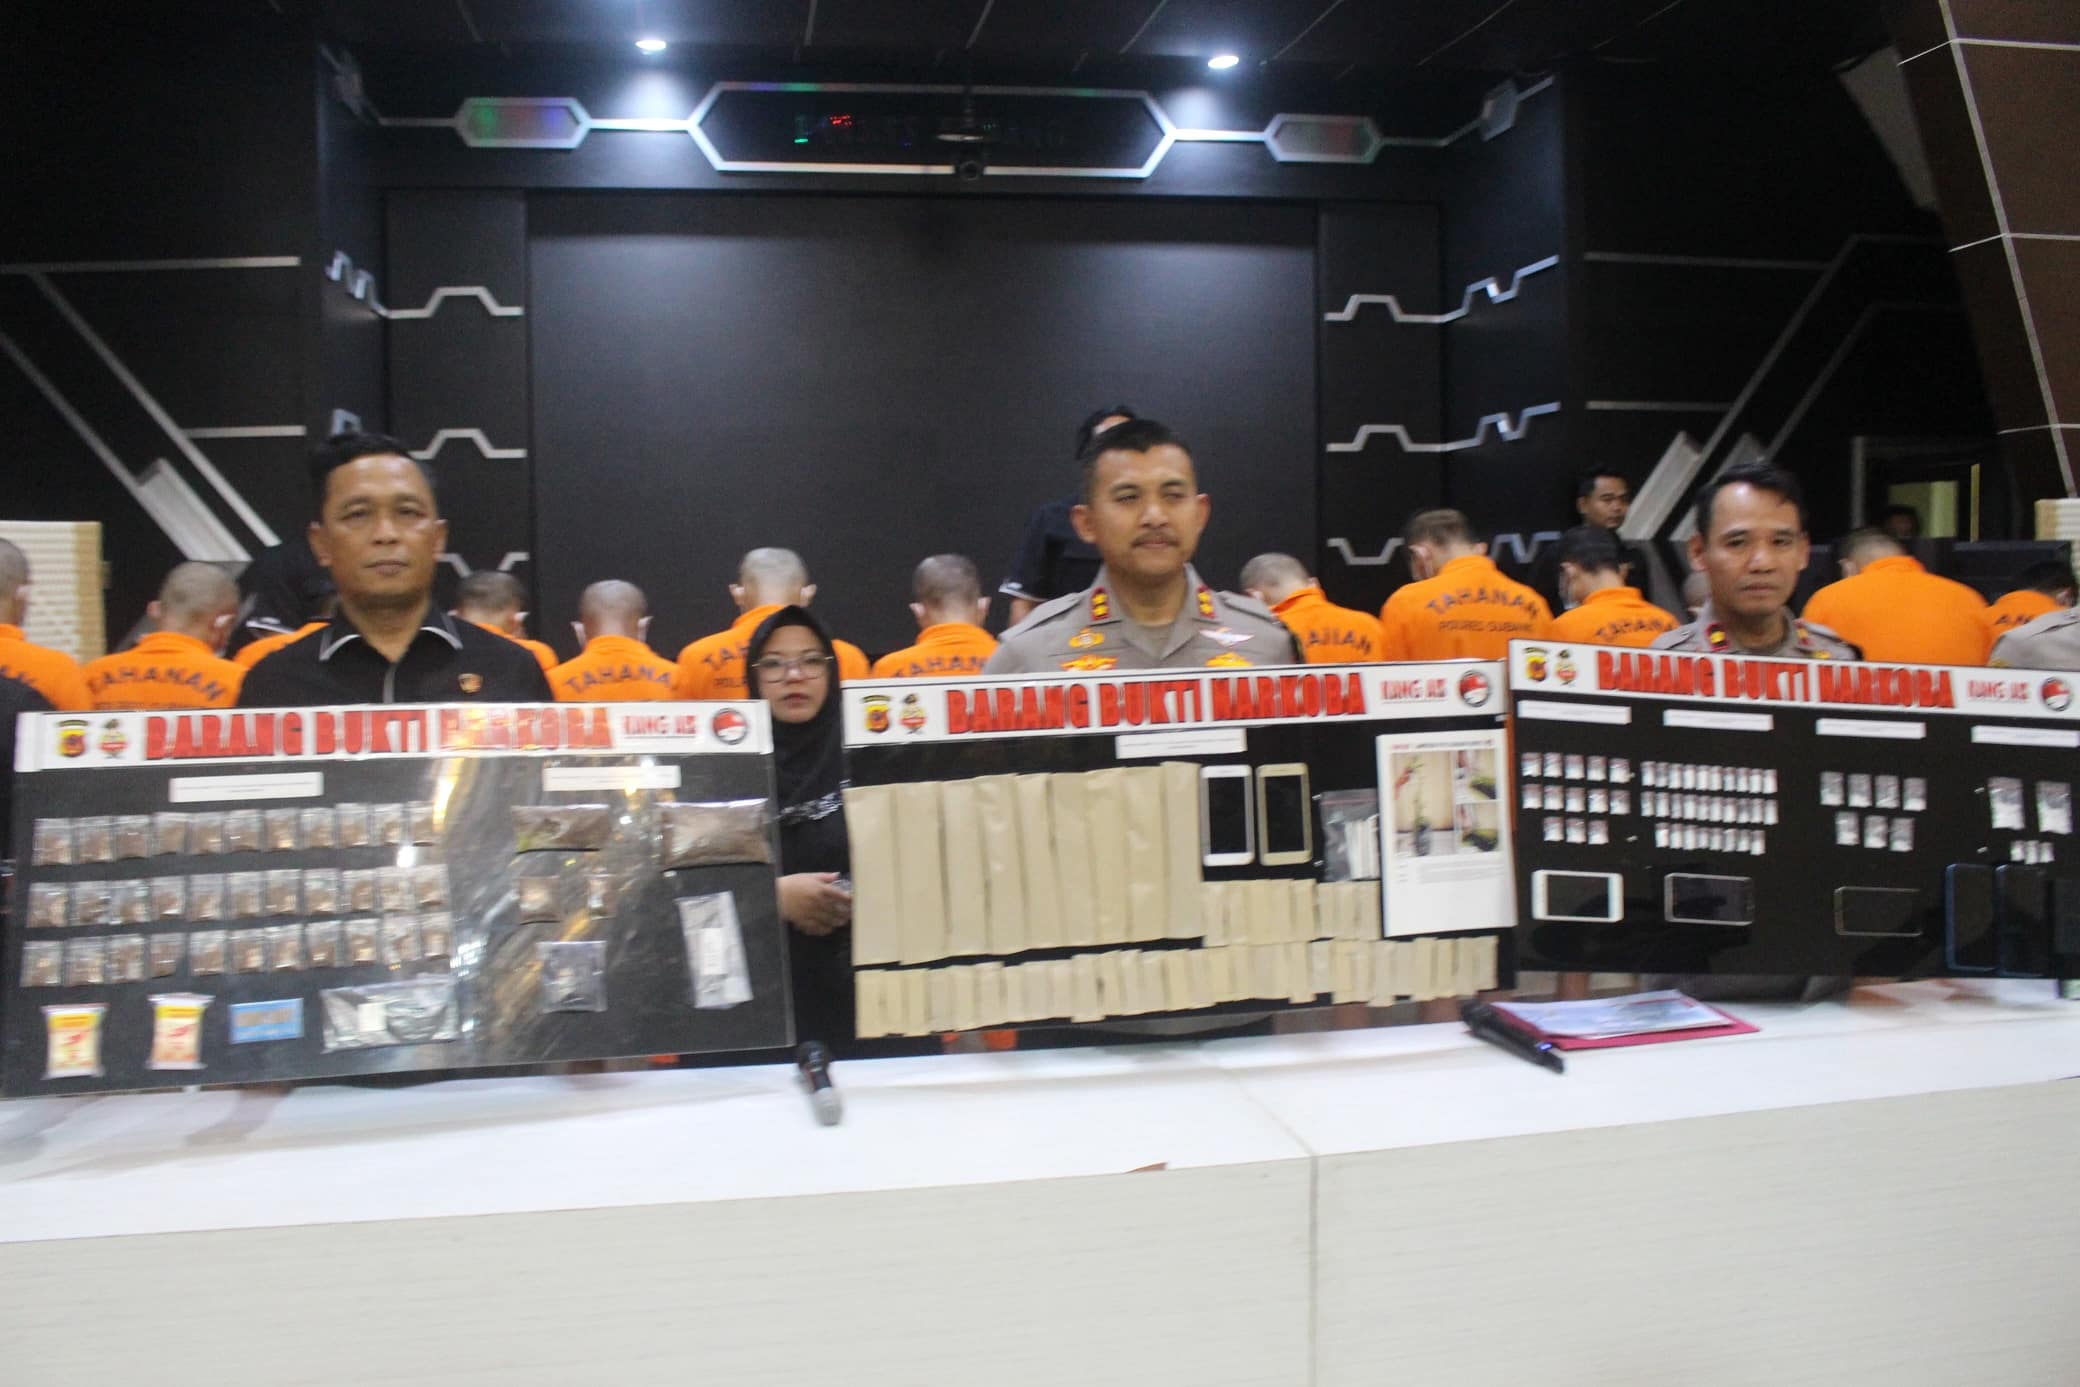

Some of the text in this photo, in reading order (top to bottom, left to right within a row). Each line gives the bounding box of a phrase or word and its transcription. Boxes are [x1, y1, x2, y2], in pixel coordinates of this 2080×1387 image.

[1596, 618, 1675, 642] TAHANA
[945, 672, 1367, 734] BARANG BUKTI NARKOBA
[1596, 650, 1956, 709] BARANG BUKTI NARKOBA
[145, 711, 304, 760] BARANG
[315, 708, 428, 754] BUKTI
